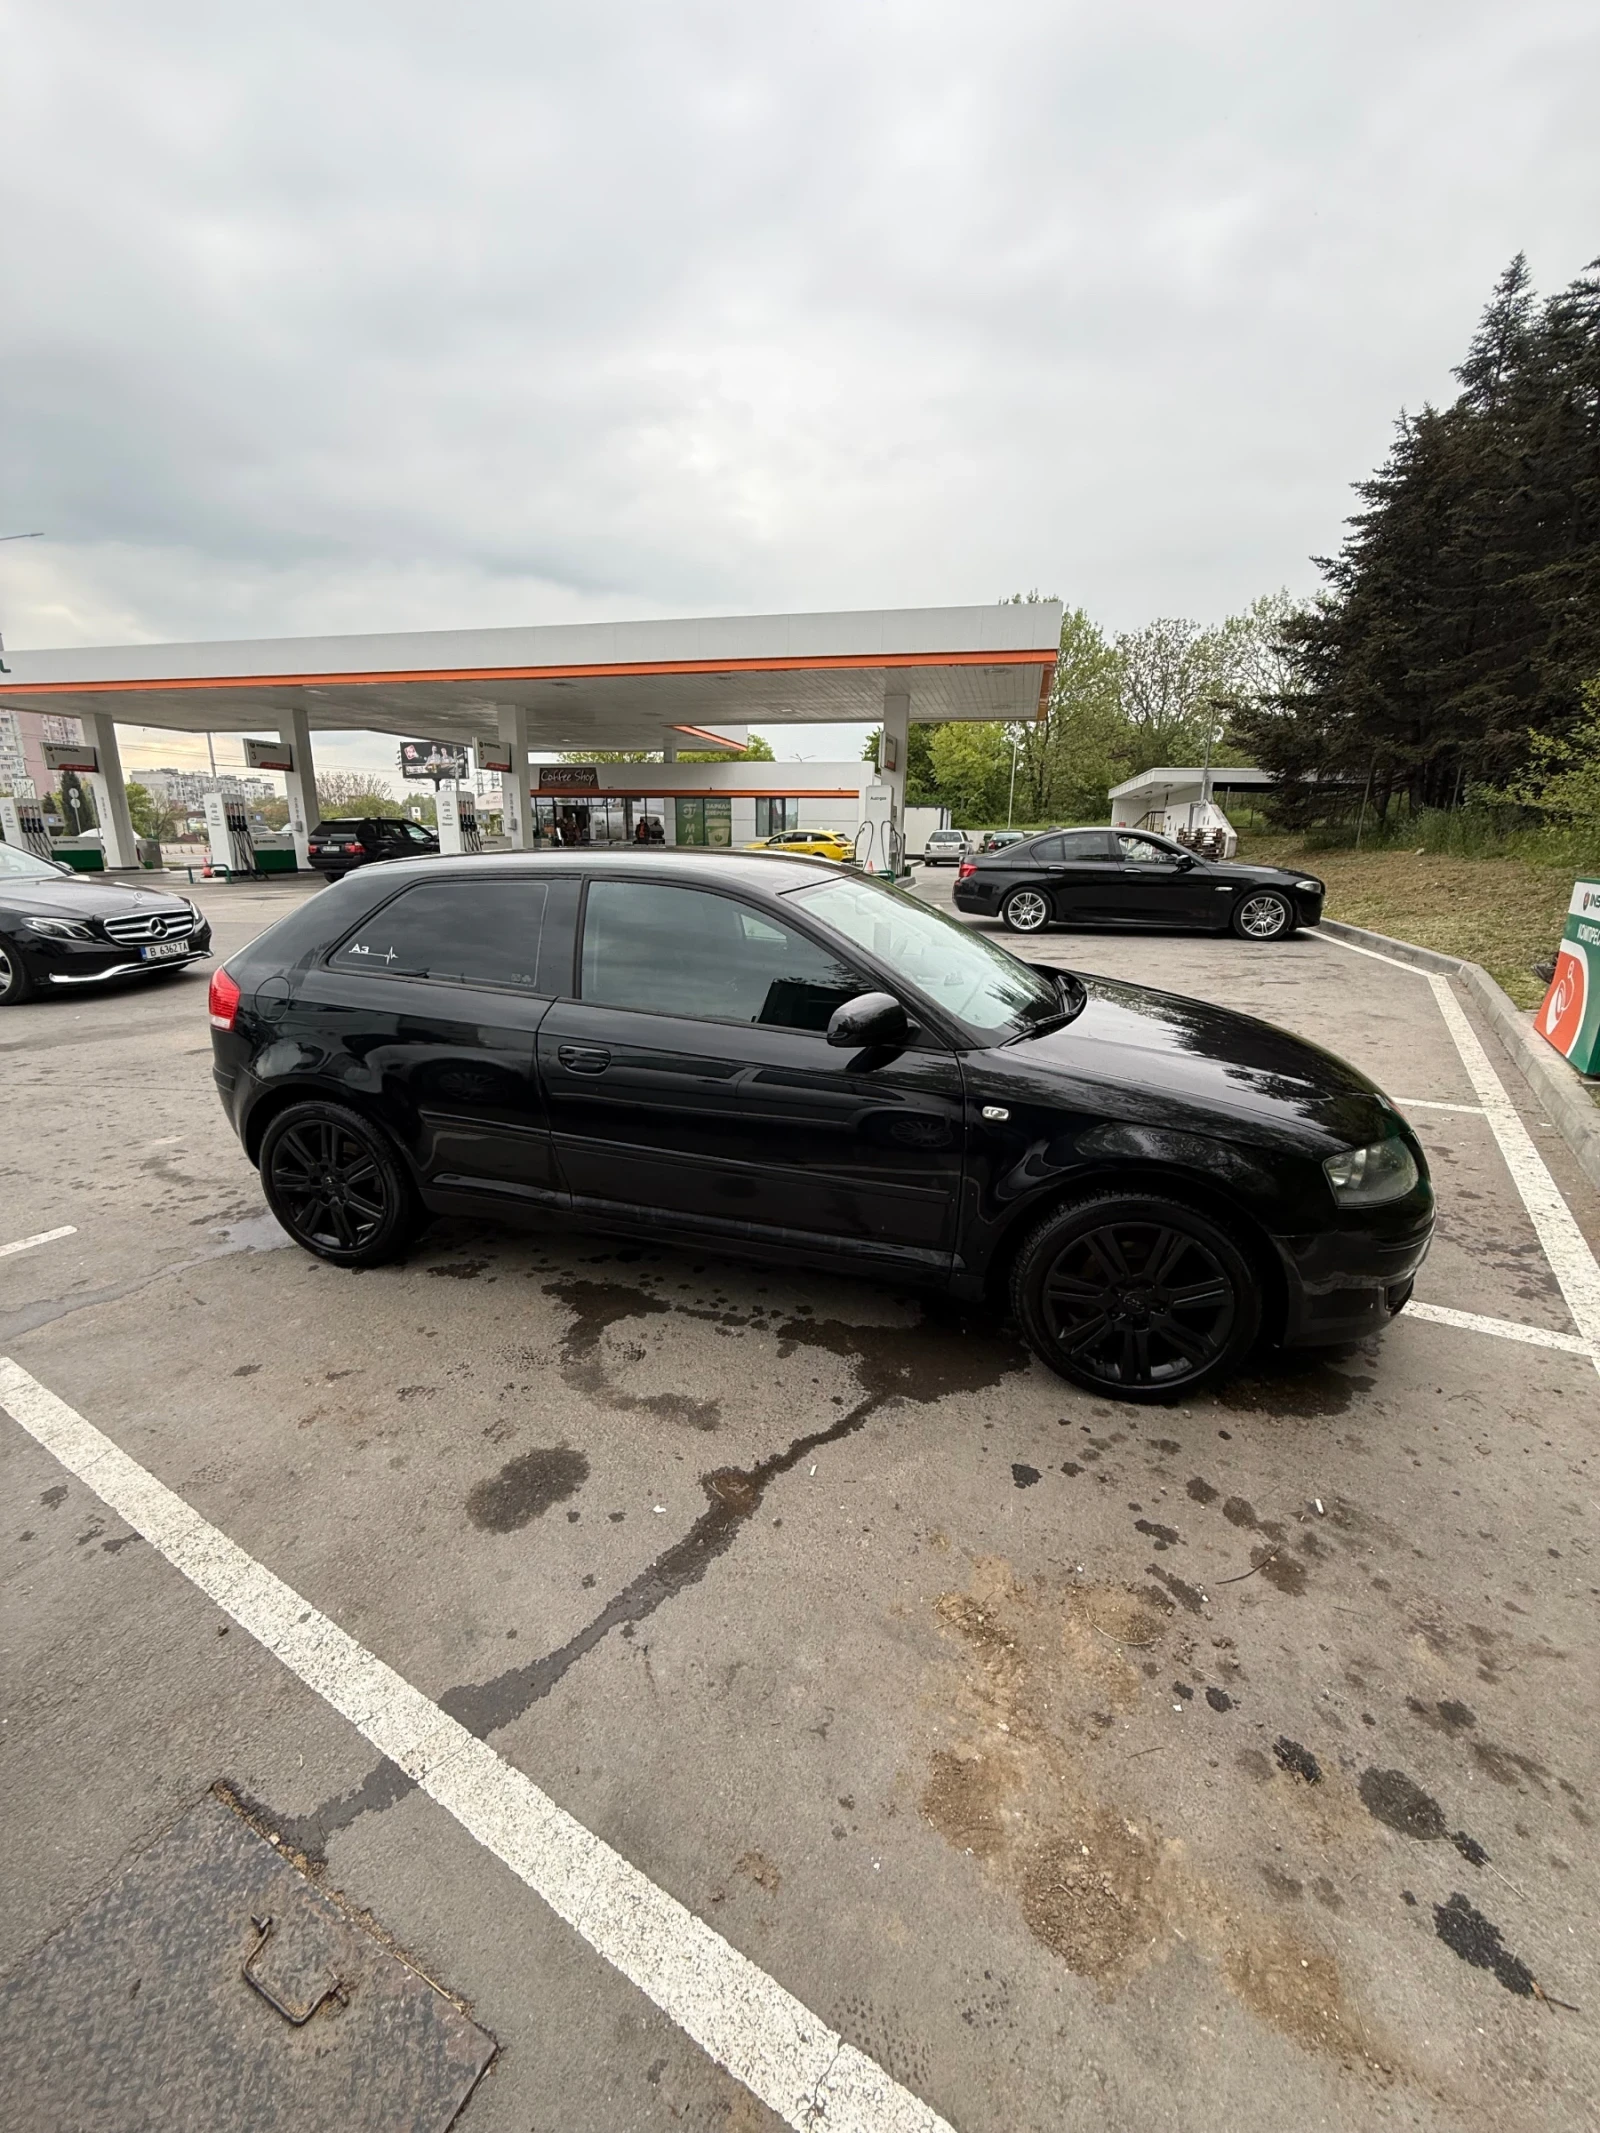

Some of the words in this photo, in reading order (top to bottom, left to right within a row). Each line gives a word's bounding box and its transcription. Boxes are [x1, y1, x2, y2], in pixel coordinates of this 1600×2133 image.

[50, 753, 55, 762] 1
[251, 751, 257, 760] 3
[480, 750, 485, 760] 5
[541, 770, 572, 782] Coffee
[575, 769, 595, 787] Shop
[150, 947, 157, 957] B
[350, 943, 370, 954] A3
